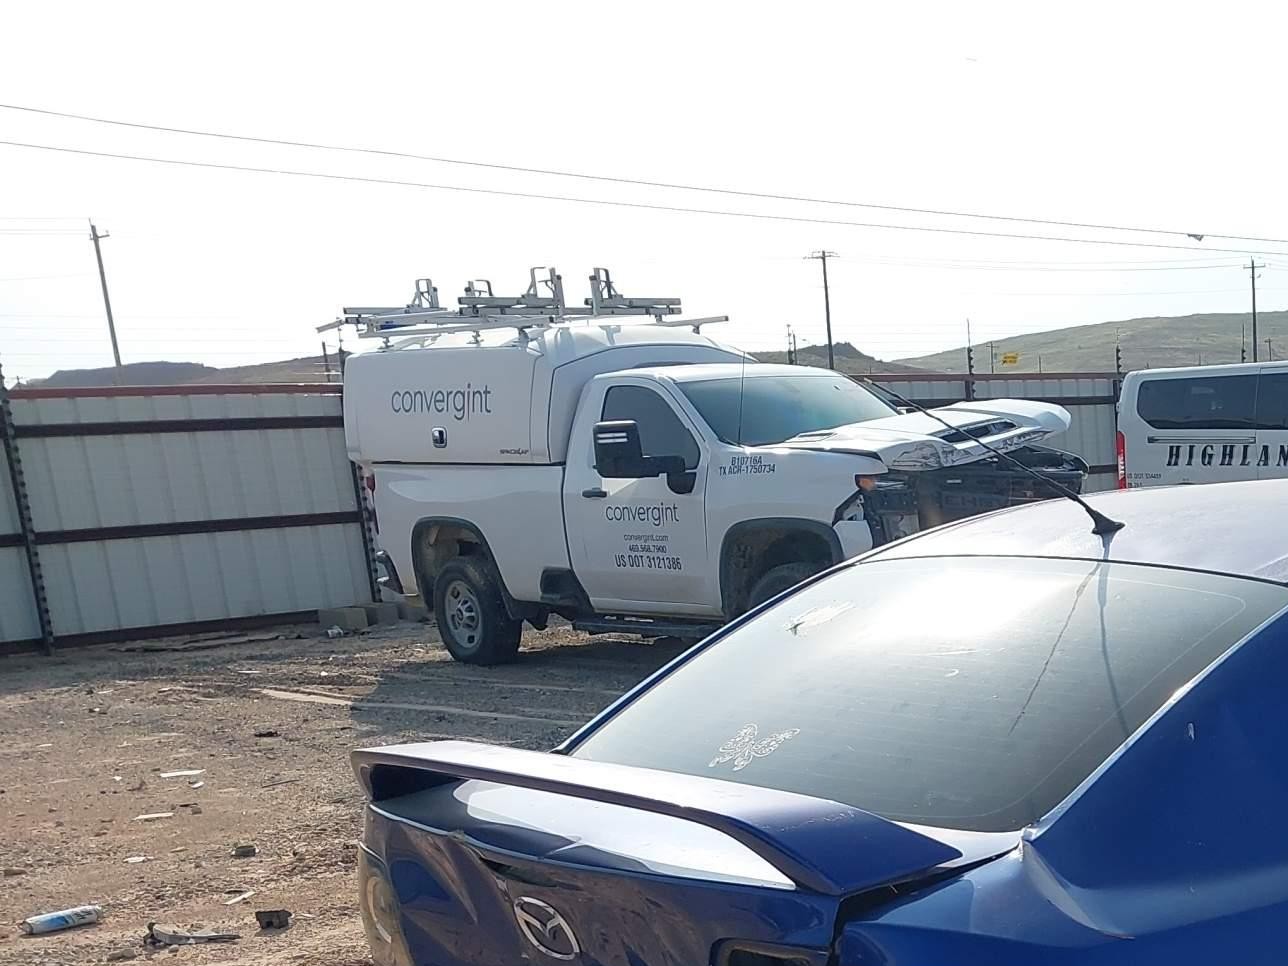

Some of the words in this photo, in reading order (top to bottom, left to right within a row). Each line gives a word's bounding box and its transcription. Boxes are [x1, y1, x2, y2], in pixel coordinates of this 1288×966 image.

[391, 382, 492, 422] convergint
[719, 466, 727, 476] TX
[605, 502, 680, 527] convergint
[615, 554, 627, 568] US
[628, 555, 645, 568] DOT
[646, 555, 682, 570] 3121386
